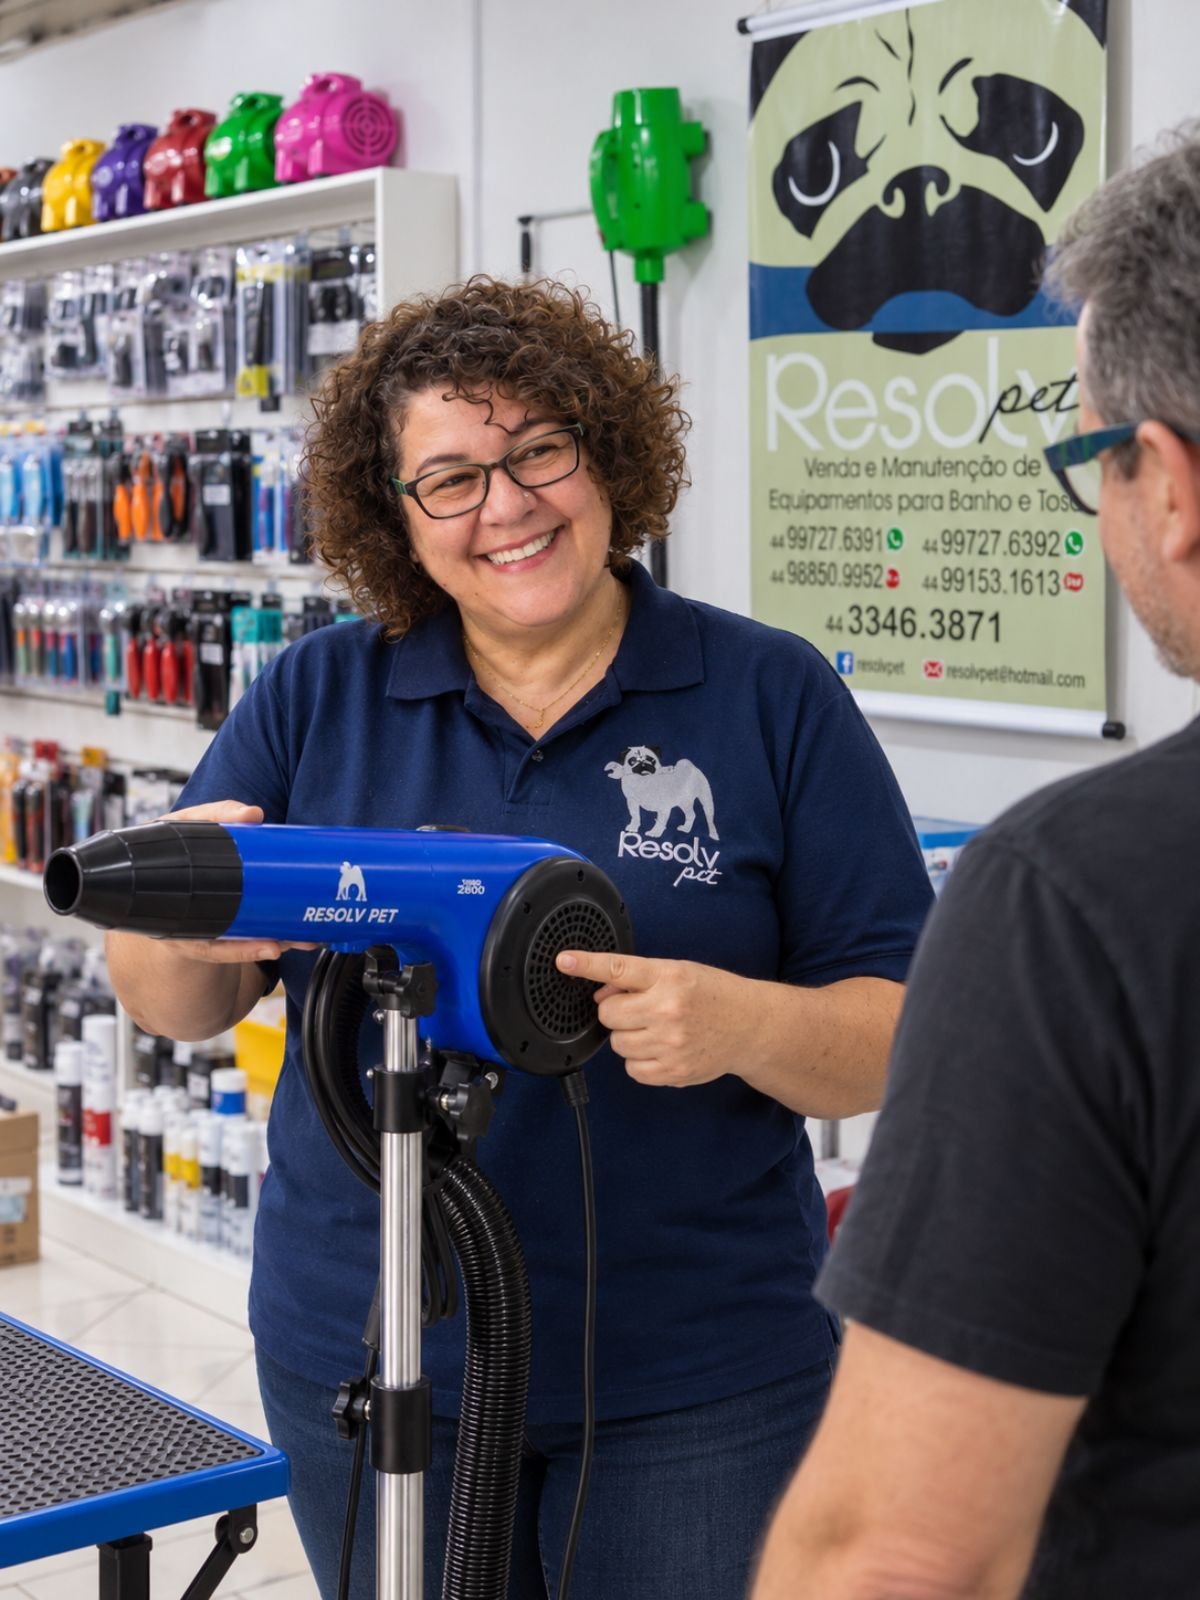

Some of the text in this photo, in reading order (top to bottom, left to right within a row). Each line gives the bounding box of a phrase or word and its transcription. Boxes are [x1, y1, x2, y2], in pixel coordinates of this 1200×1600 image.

[767, 336, 1078, 451] Resolv
[978, 373, 1079, 443] pet
[804, 455, 1041, 482] Venda e Manutenção de
[769, 489, 892, 514] Equipamentos
[898, 493, 944, 514] para
[949, 489, 1011, 512] Banho
[1019, 493, 1031, 512] e
[770, 526, 883, 551] 44 99727.6391
[923, 530, 1060, 557] 44 99727.6392
[770, 570, 785, 583] 44
[923, 578, 939, 591] 44
[941, 566, 1060, 596] 99153.1613
[826, 605, 1000, 643] 44 3346.3871
[856, 658, 905, 676] resolvpet
[946, 664, 1086, 689] resolvpet@hotmail.com
[617, 831, 720, 870] Resolv
[302, 906, 399, 923] RESOLV PET
